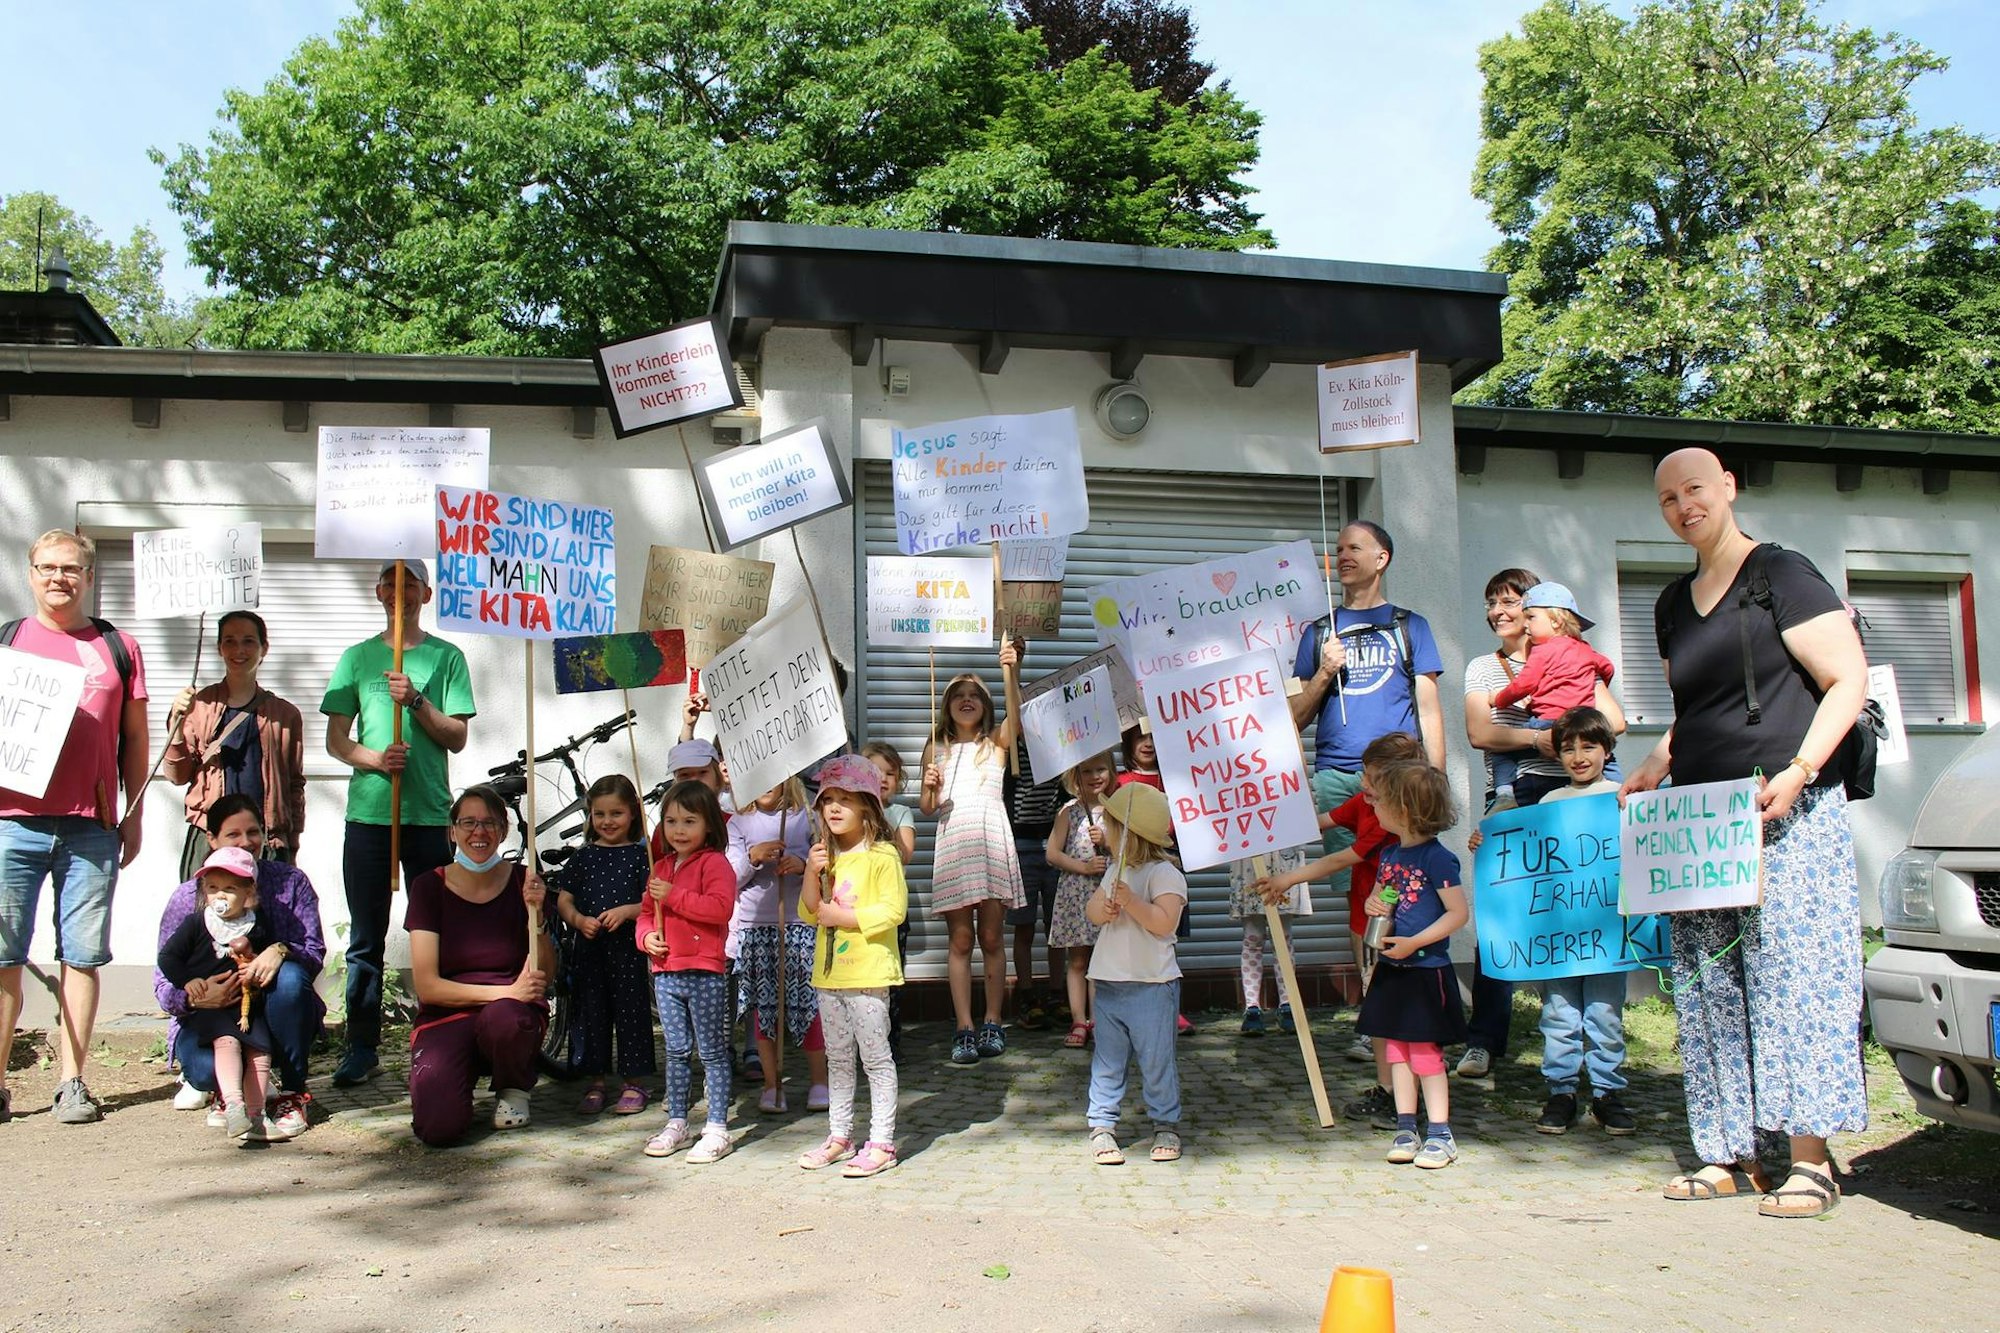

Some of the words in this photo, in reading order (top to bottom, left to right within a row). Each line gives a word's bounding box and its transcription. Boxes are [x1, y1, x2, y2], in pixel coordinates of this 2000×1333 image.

[612, 364, 631, 378] Ihr
[636, 343, 714, 372] Kinderlein
[616, 369, 676, 394] kommet
[640, 382, 707, 409] NICHT???
[1329, 382, 1345, 393] Ev.
[1349, 378, 1370, 391] Kita
[1374, 373, 1405, 387] Köln-
[1342, 394, 1392, 411] Zollstock
[326, 433, 343, 444] Die
[1332, 420, 1358, 432] muss
[1361, 412, 1404, 428] bleiben!
[894, 431, 957, 459] Jesus
[730, 472, 752, 488] Ich
[757, 458, 783, 478] will
[788, 452, 802, 466] in
[896, 463, 928, 482] Alle
[936, 452, 1008, 478] Kinder
[1013, 456, 1057, 475] dürfen
[729, 481, 779, 509] meiner
[784, 467, 816, 487] Kita
[898, 489, 911, 501] zu
[918, 485, 938, 499] mir
[945, 474, 1003, 496] kommen!
[439, 490, 501, 525] WIR
[507, 497, 568, 530] SIND
[571, 507, 614, 542] HIER
[747, 489, 808, 522] bleiben!
[899, 511, 926, 527] Das
[932, 502, 959, 527] gilt
[965, 504, 985, 521] für
[992, 499, 1037, 515] diese
[438, 519, 490, 555] WIR
[490, 528, 549, 559] SIND
[551, 537, 614, 568] LAUT
[908, 522, 981, 554] Kirche
[437, 551, 487, 588] WEIL
[490, 556, 557, 595] MAHN
[569, 568, 616, 603] UNS
[651, 553, 686, 575] WIR
[695, 561, 731, 581] SIND
[738, 570, 768, 590] HIER
[170, 575, 253, 608] RECHTE
[650, 578, 681, 598] WIR
[688, 587, 726, 605] SIND
[729, 593, 763, 614] LAUT
[916, 580, 971, 599] KITA
[1178, 578, 1301, 620] brauchen
[440, 588, 473, 619] DIE
[480, 589, 552, 632] KITA
[556, 599, 616, 634] KLAUT
[645, 606, 681, 625] WEIL
[690, 613, 712, 629] IHR
[721, 616, 748, 633] UNS
[891, 618, 931, 633] UNSERE
[912, 605, 943, 615] dann
[685, 640, 709, 655] ITA
[1139, 644, 1222, 676] unsere
[1346, 646, 1396, 669] GINALS
[707, 649, 752, 699] BITTE
[718, 671, 781, 733] RETTET
[788, 647, 822, 690] DEN
[1063, 680, 1092, 703] Kita
[1157, 669, 1275, 724] UNSERE
[1186, 713, 1264, 753] KITA
[1191, 749, 1268, 788] MUSS
[1176, 770, 1300, 823] BLEIBEN
[1628, 798, 1658, 826] ICH
[1665, 793, 1716, 822] WILL
[1728, 790, 1749, 814] IN
[1492, 827, 1570, 879] FÜR
[1577, 833, 1620, 867] DE
[1635, 827, 1698, 856] MEINER
[1706, 819, 1754, 852] KITA
[1648, 859, 1758, 894] BLEIBEN!
[1529, 875, 1619, 915] ERHAL
[1490, 929, 1607, 970] UNSERER
